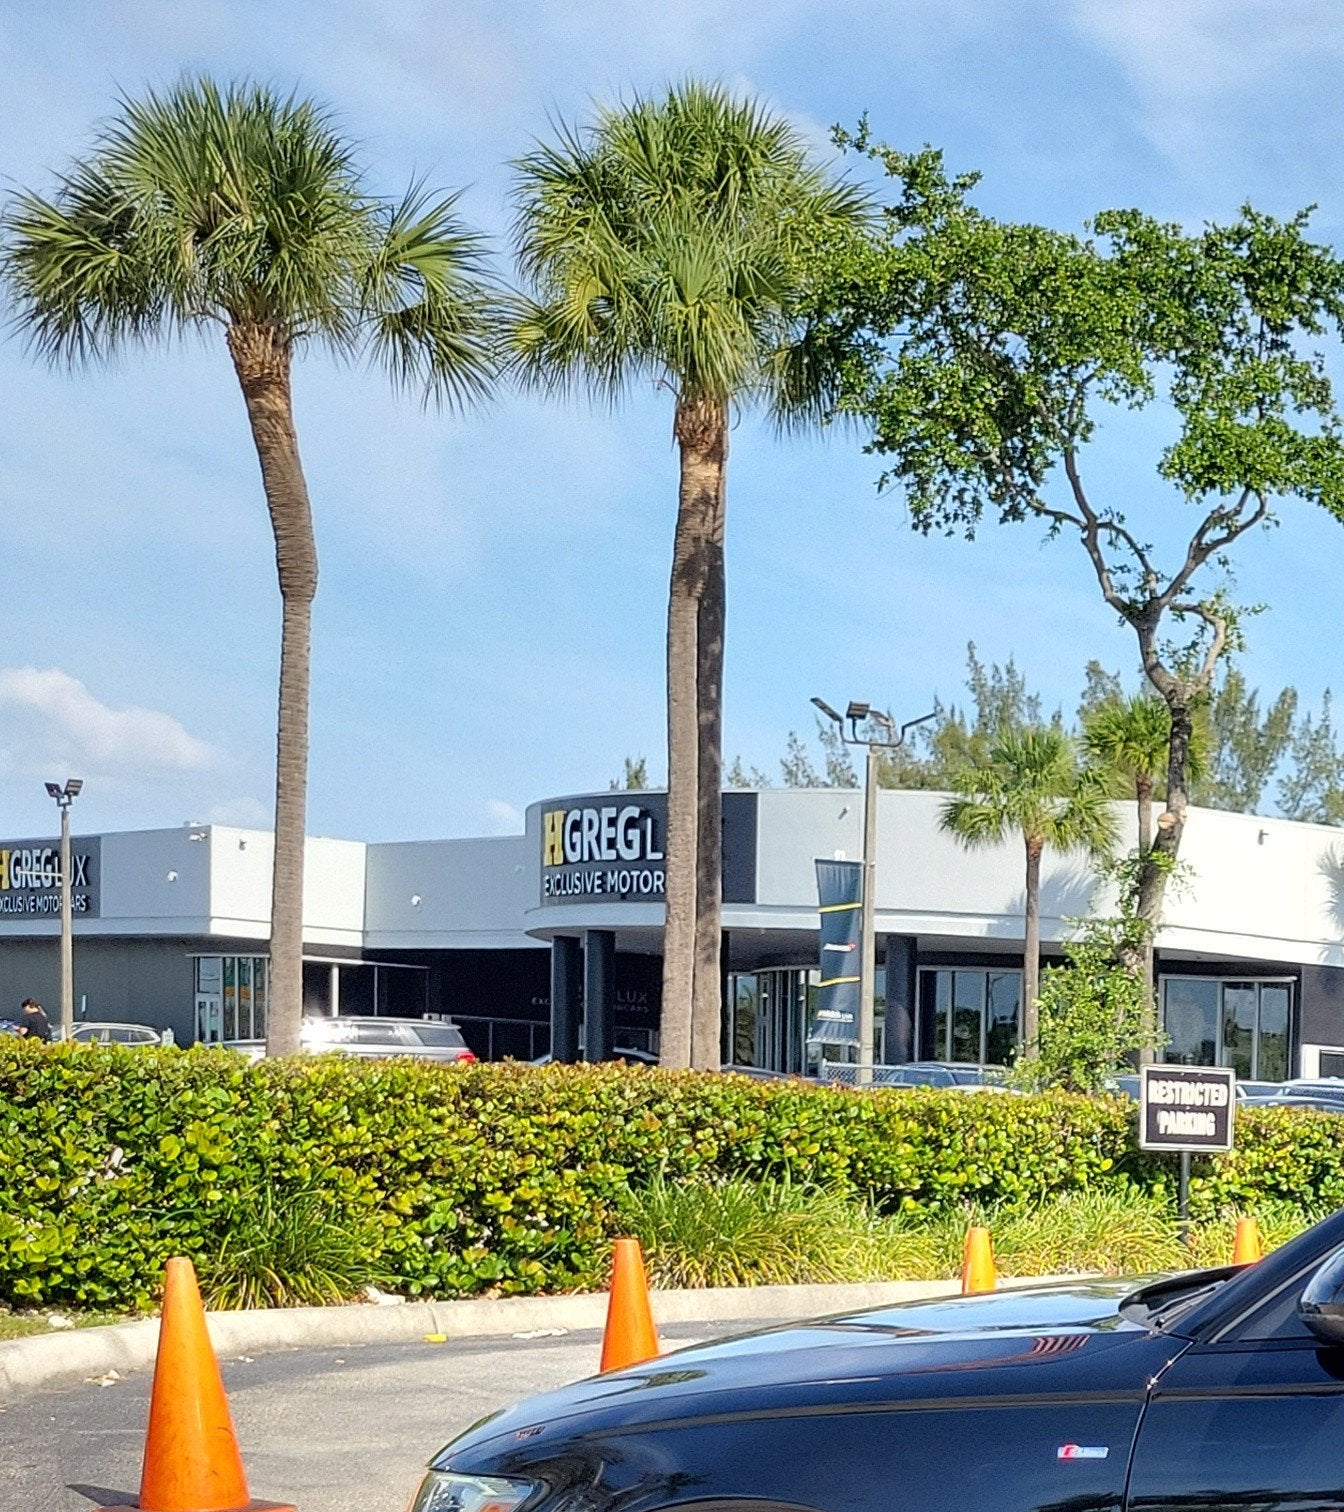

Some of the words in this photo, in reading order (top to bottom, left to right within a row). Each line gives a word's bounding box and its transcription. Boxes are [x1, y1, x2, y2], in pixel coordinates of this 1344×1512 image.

[544, 870, 602, 897] EXCLUSIVE
[1148, 1079, 1229, 1107] RESTRICTED
[1157, 1110, 1216, 1137] PARKING
